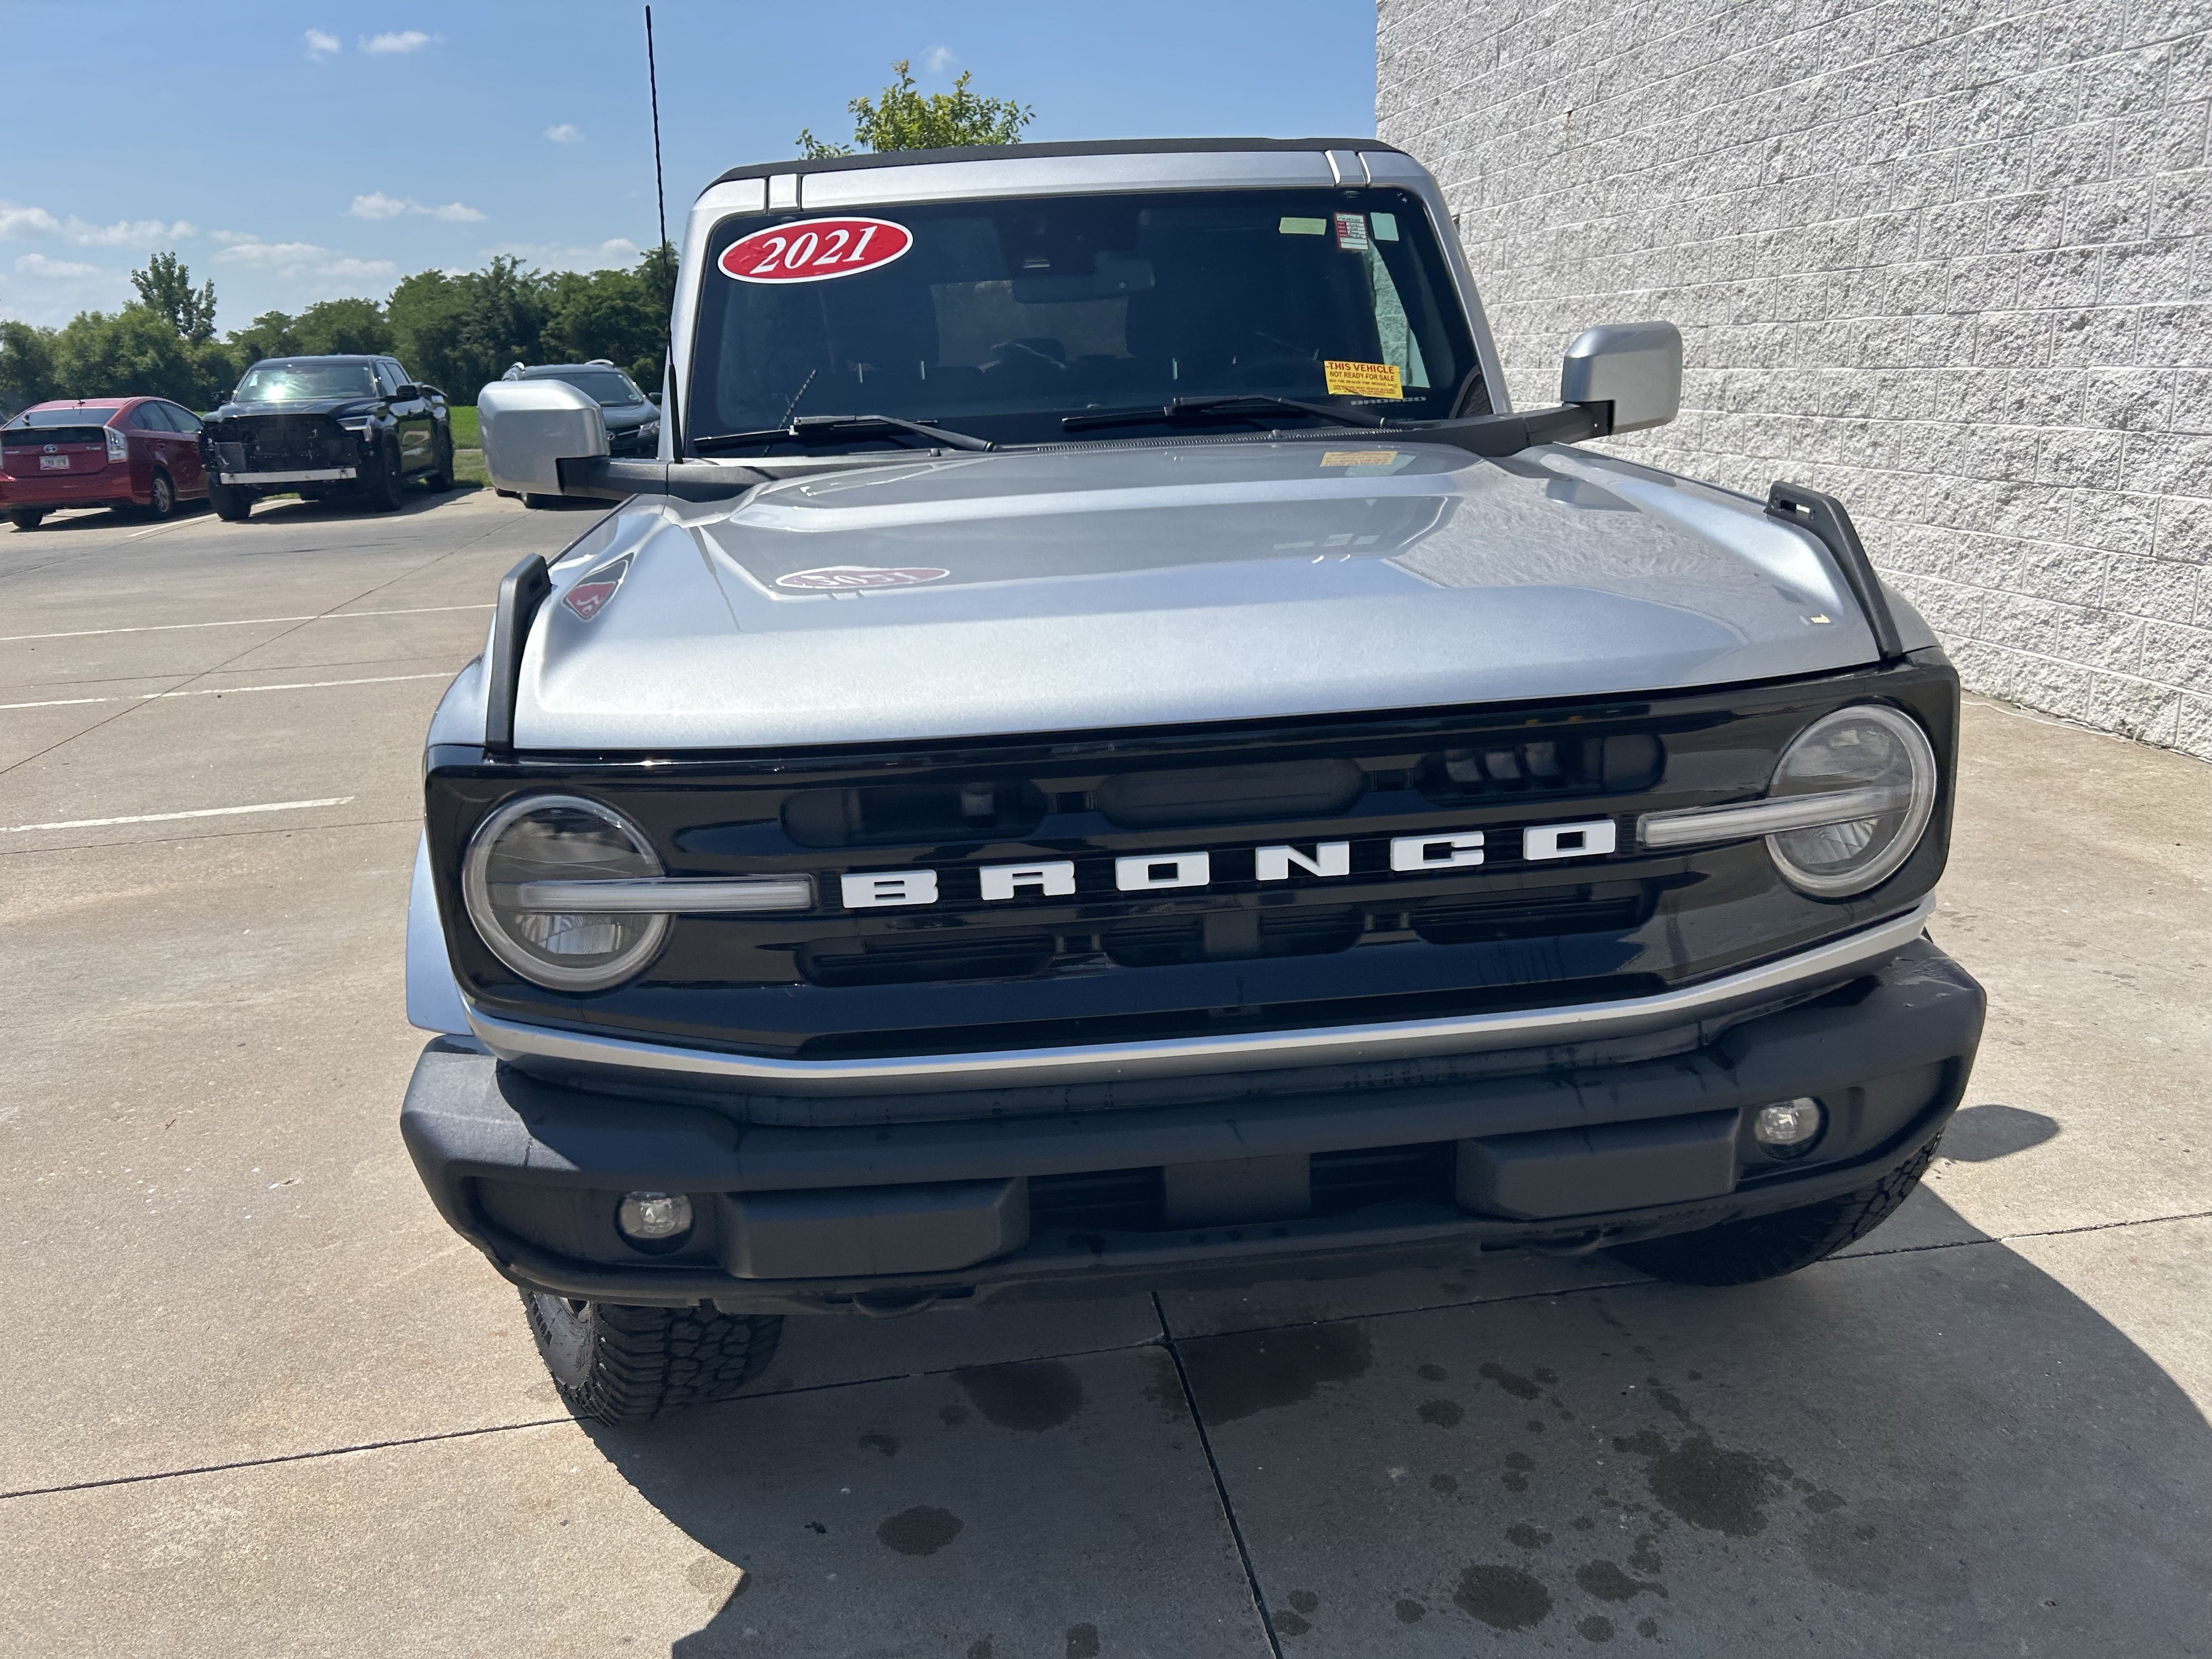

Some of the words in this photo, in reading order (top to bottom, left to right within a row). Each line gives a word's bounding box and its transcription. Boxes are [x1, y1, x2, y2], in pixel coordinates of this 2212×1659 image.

[749, 225, 878, 274] 2021
[1328, 362, 1351, 370] THIS
[1353, 364, 1395, 374] VEHICLE
[840, 819, 1616, 909] BRONCO
